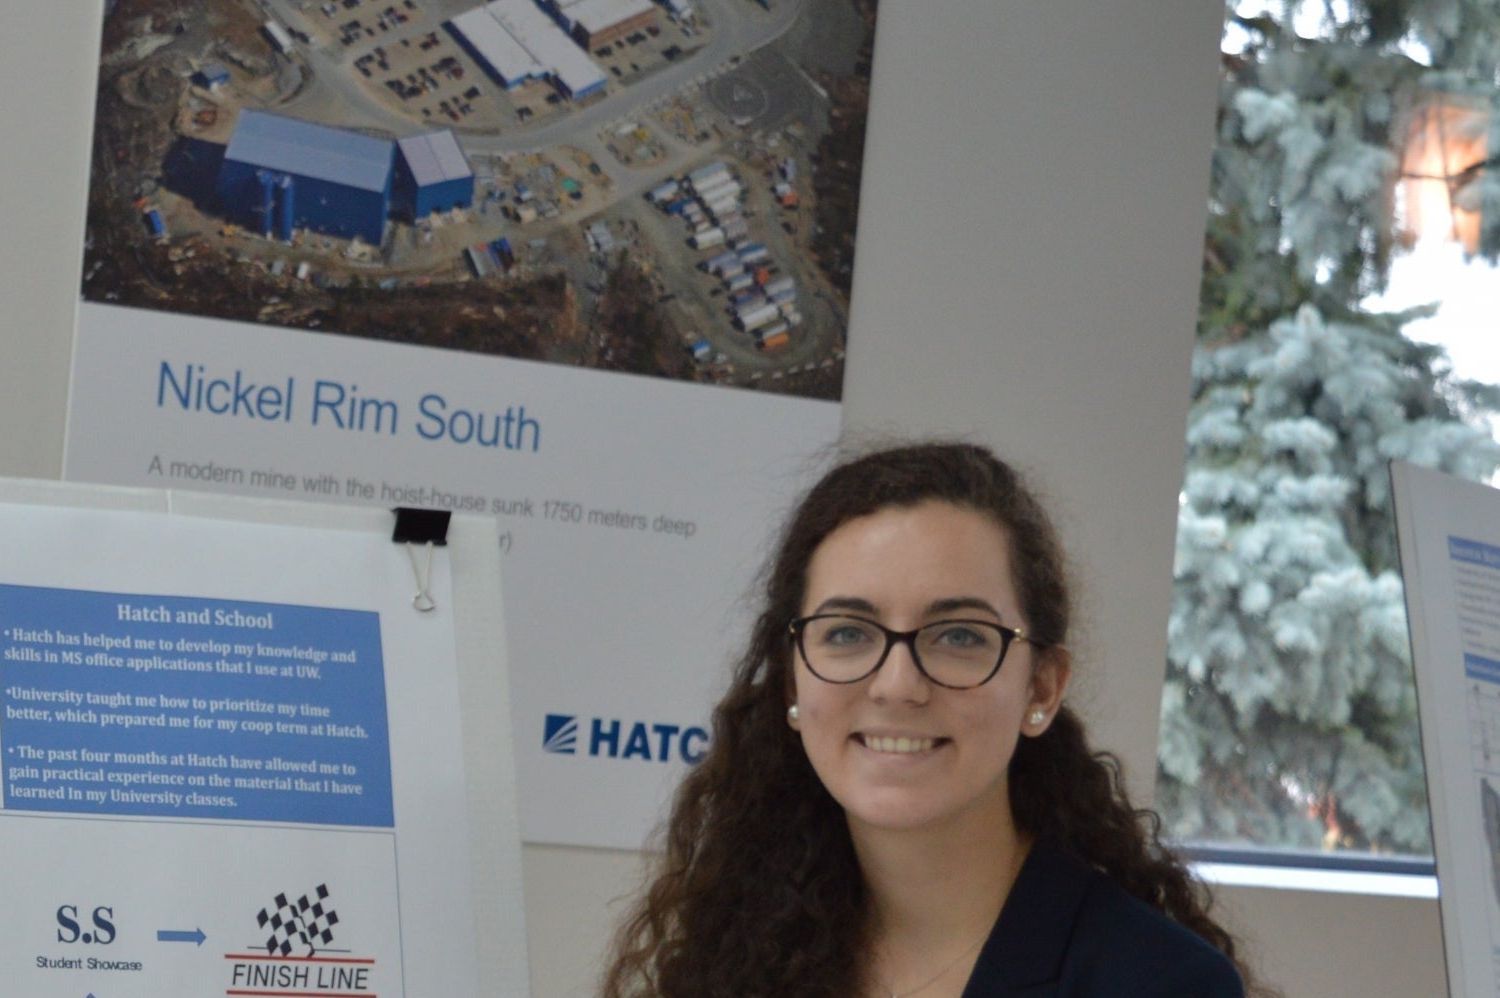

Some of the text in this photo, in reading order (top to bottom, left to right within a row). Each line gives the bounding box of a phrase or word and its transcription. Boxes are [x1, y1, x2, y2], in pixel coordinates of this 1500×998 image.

[156, 360, 540, 453] Nickel Rim South
[147, 454, 697, 539] A modern mine with the hoist-house sunk 1750 meters deep
[117, 603, 273, 630] Hatch and School
[12, 627, 356, 663] Hatch has helped me to develop my knowledge and
[3, 646, 321, 679] skills in MS office applications that I use at UW.
[85, 691, 132, 709] taught
[134, 695, 157, 708] me
[159, 693, 190, 709] how
[191, 697, 207, 710] to
[208, 697, 275, 714] prioritize
[277, 703, 297, 718] my
[299, 703, 330, 717] time
[5, 704, 368, 738] better, which prepared me for my coop term at Hatch.
[589, 718, 708, 765] HATC
[16, 744, 356, 775] The past four months at Hatch have allowed me to
[8, 764, 362, 795] gain practical experience on the material that I have
[9, 782, 65, 800] learned
[85, 789, 107, 805] my
[110, 788, 183, 808] University
[184, 791, 237, 807] classes.
[55, 904, 117, 945] S.S
[35, 955, 142, 971] Student Showcase
[231, 963, 369, 990] FINISH LINE
